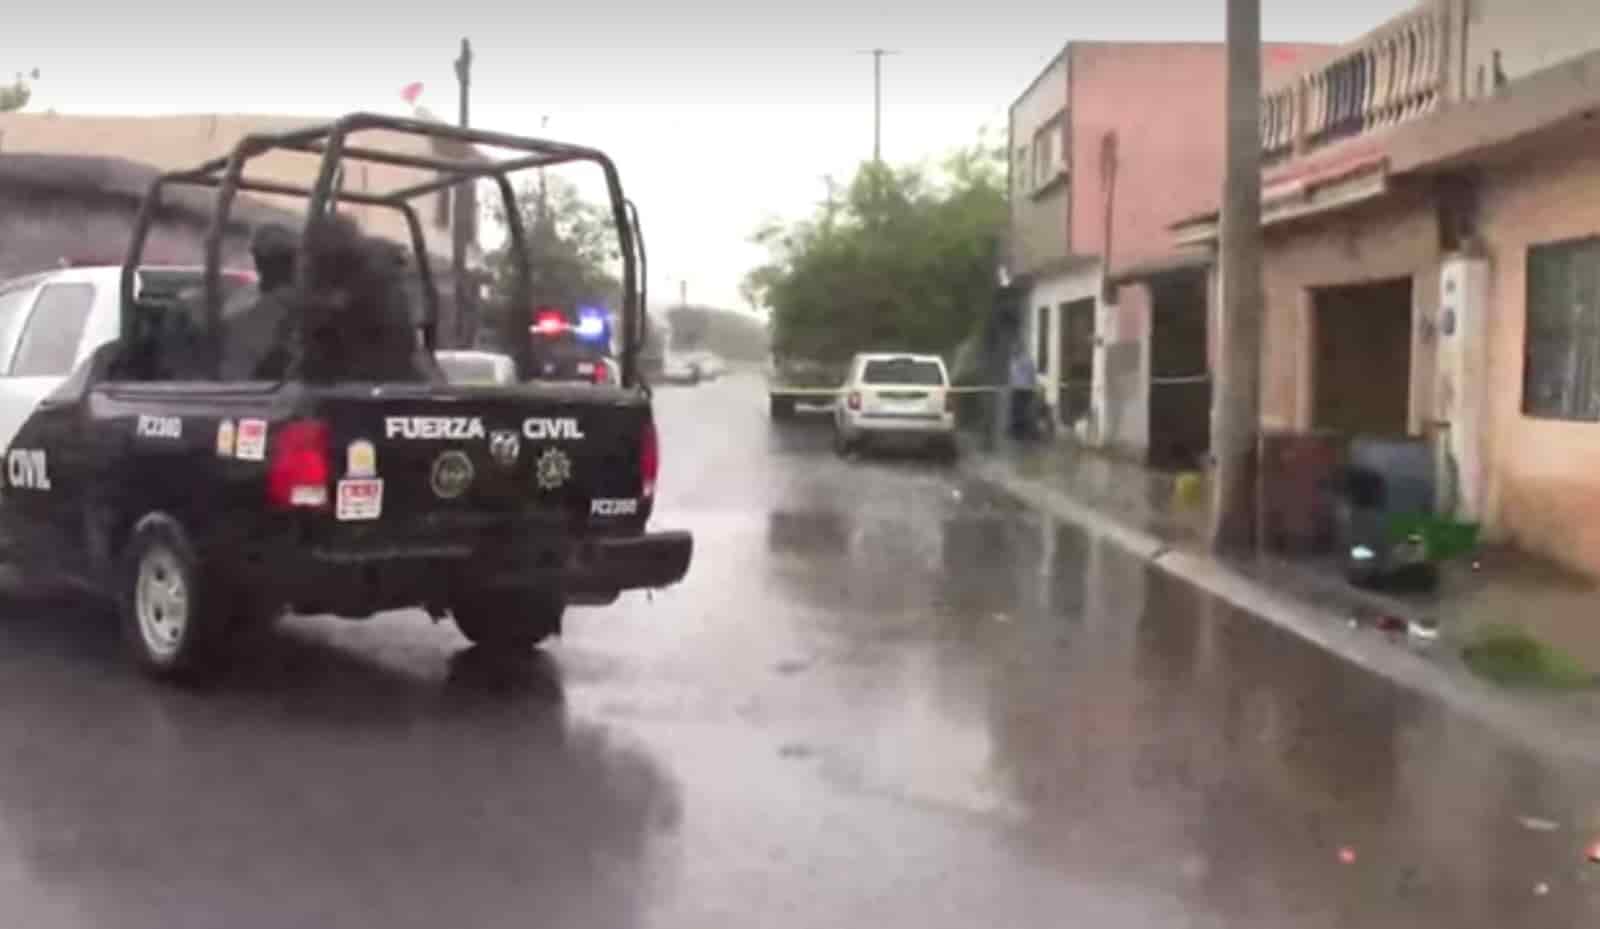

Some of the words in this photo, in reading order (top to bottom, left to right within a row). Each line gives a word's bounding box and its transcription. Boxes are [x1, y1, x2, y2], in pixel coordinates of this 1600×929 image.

[385, 416, 485, 439] FUERZA
[522, 417, 585, 439] CIVIL
[8, 449, 51, 490] CIVIL
